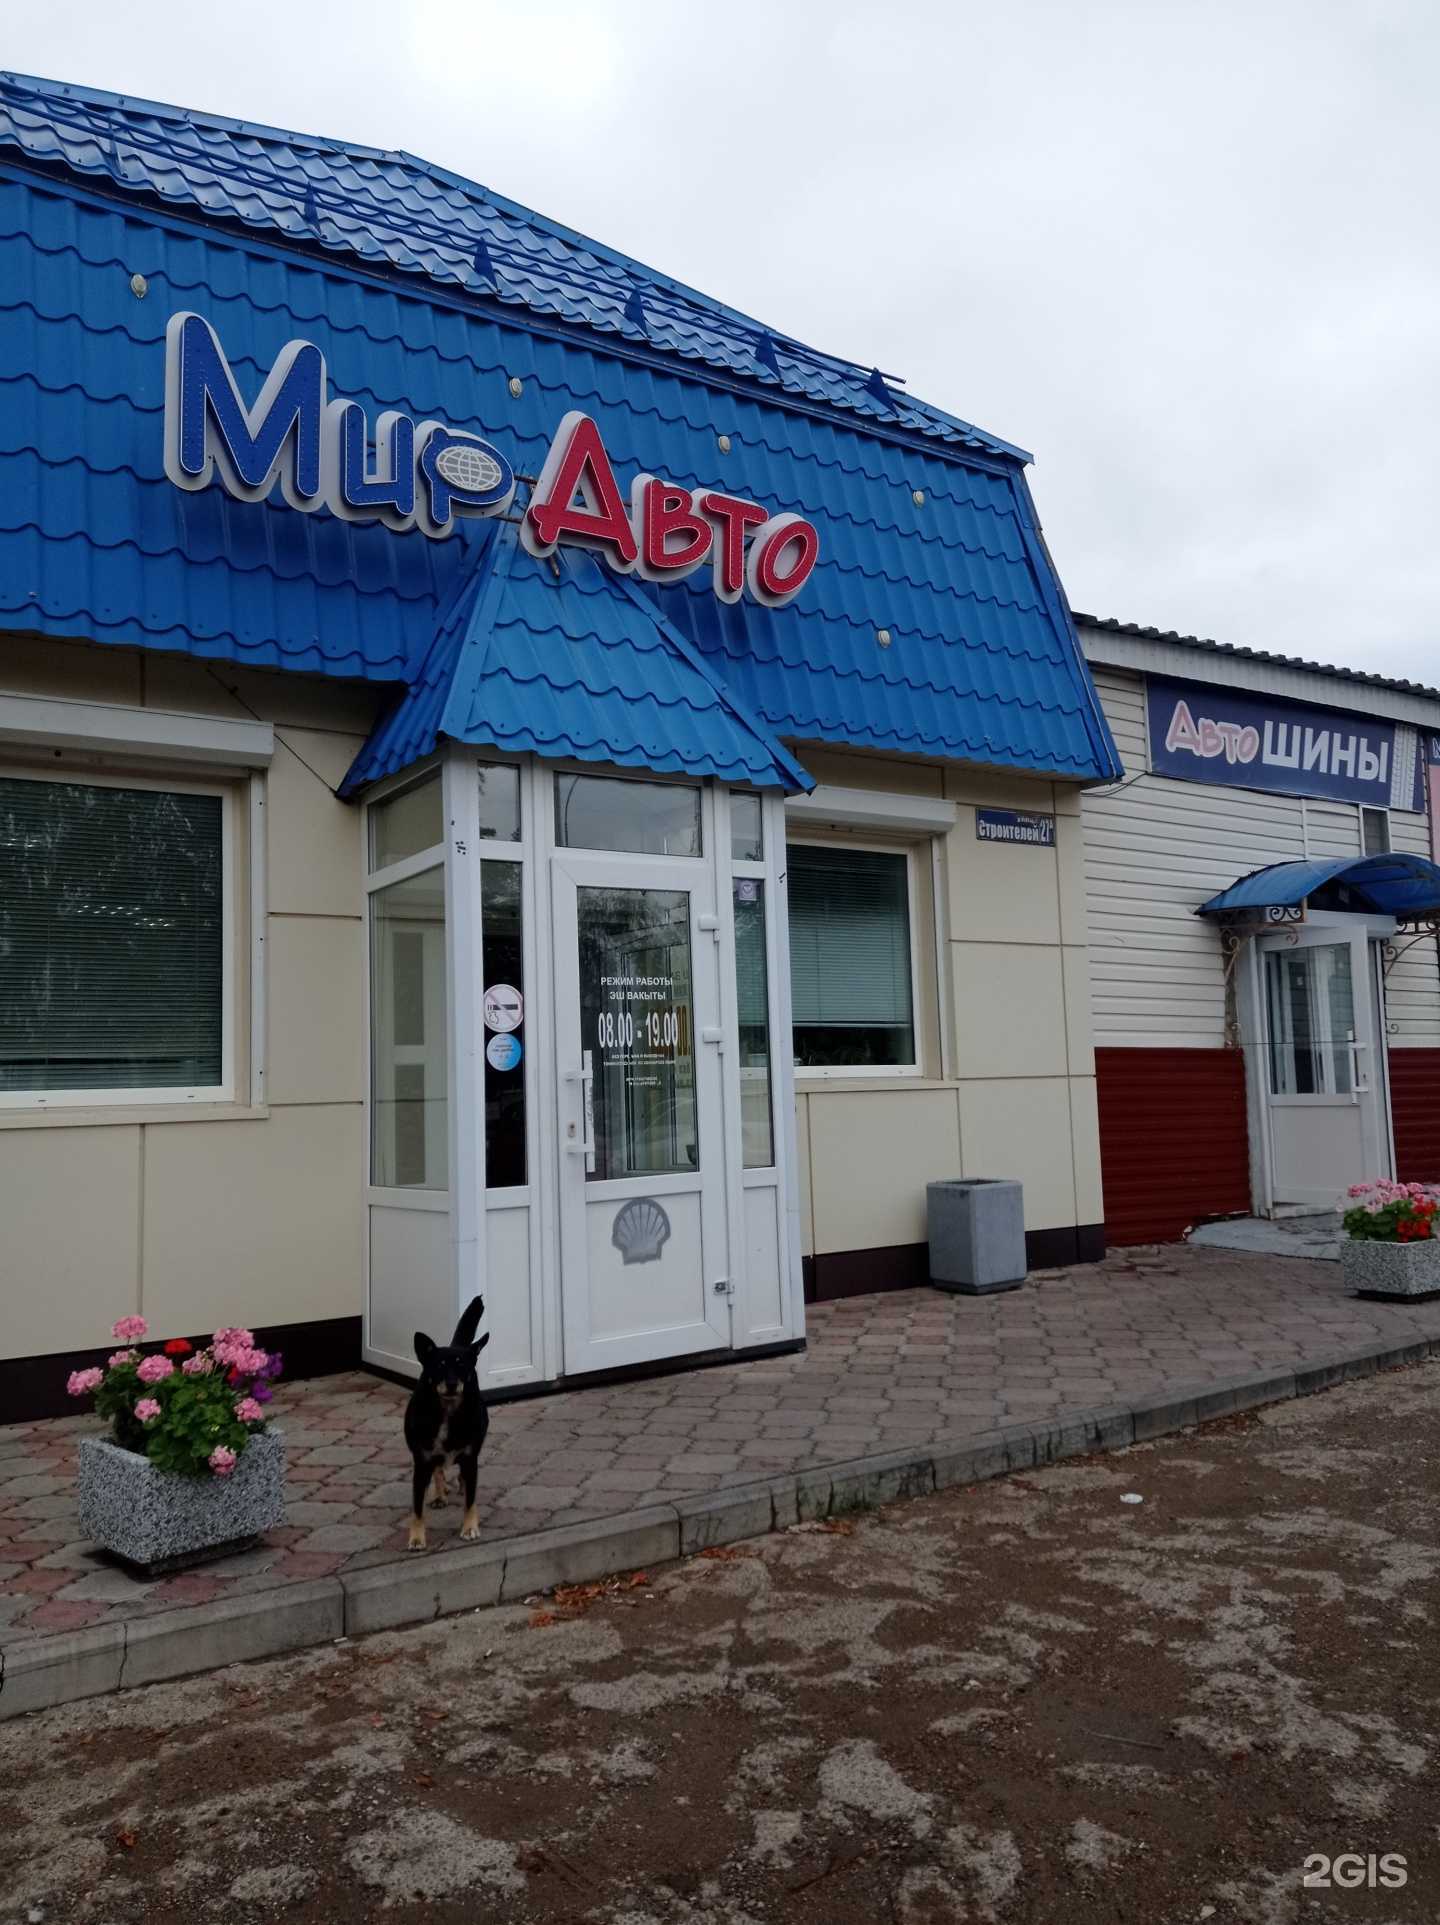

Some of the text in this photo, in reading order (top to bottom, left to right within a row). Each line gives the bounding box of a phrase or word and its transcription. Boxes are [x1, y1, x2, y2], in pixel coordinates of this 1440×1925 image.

[164, 311, 819, 608] Мир Авто
[600, 977, 673, 986] РЕЖИМ РАБОТЫ
[609, 992, 625, 1000] ЭШ
[598, 1012, 633, 1048] 08.00
[645, 1012, 679, 1047] 19.00
